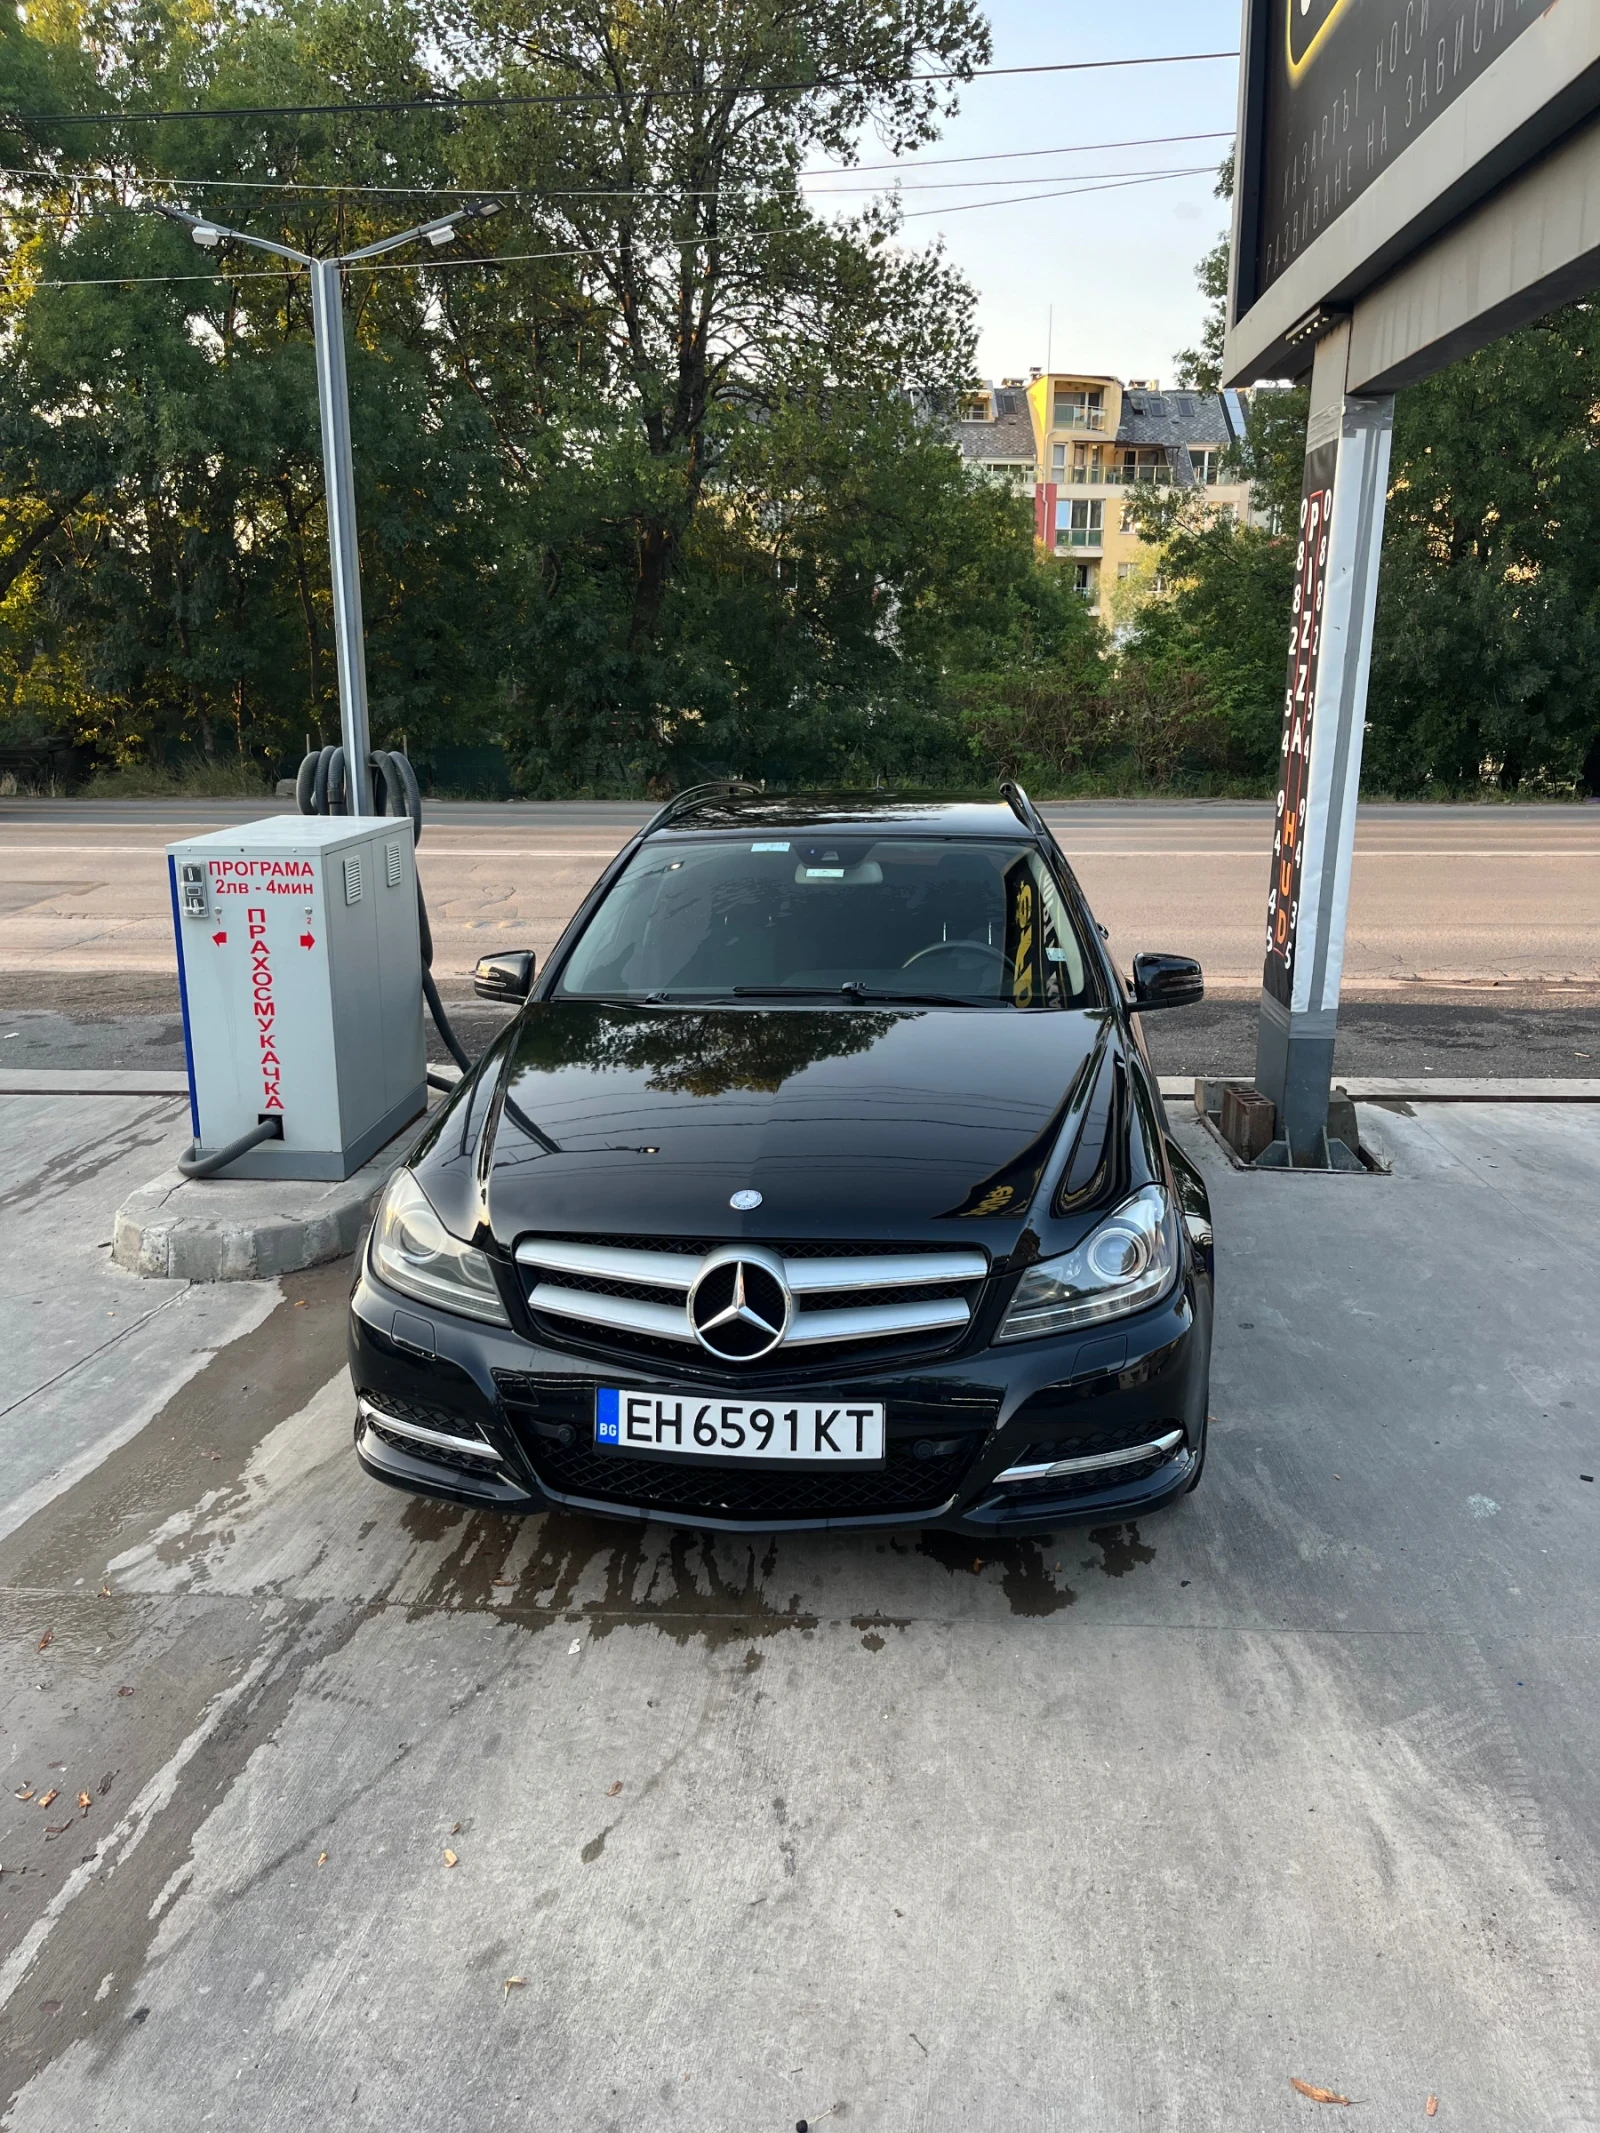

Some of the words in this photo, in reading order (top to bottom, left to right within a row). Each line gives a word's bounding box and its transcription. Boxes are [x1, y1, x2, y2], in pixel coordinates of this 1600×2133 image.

[1265, 145, 1352, 283] РАЗВИВАНЕ
[1366, 105, 1388, 170] НА
[1290, 501, 1319, 752] PIZZA
[208, 861, 315, 877] ПРОГРАМА
[215, 879, 249, 894] 2лв
[266, 879, 314, 895] 4мин
[1276, 809, 1296, 945] HUD
[306, 917, 312, 925] 2
[247, 908, 285, 1110] ПРАХОСМУКАЧКА
[599, 1422, 617, 1437] BG
